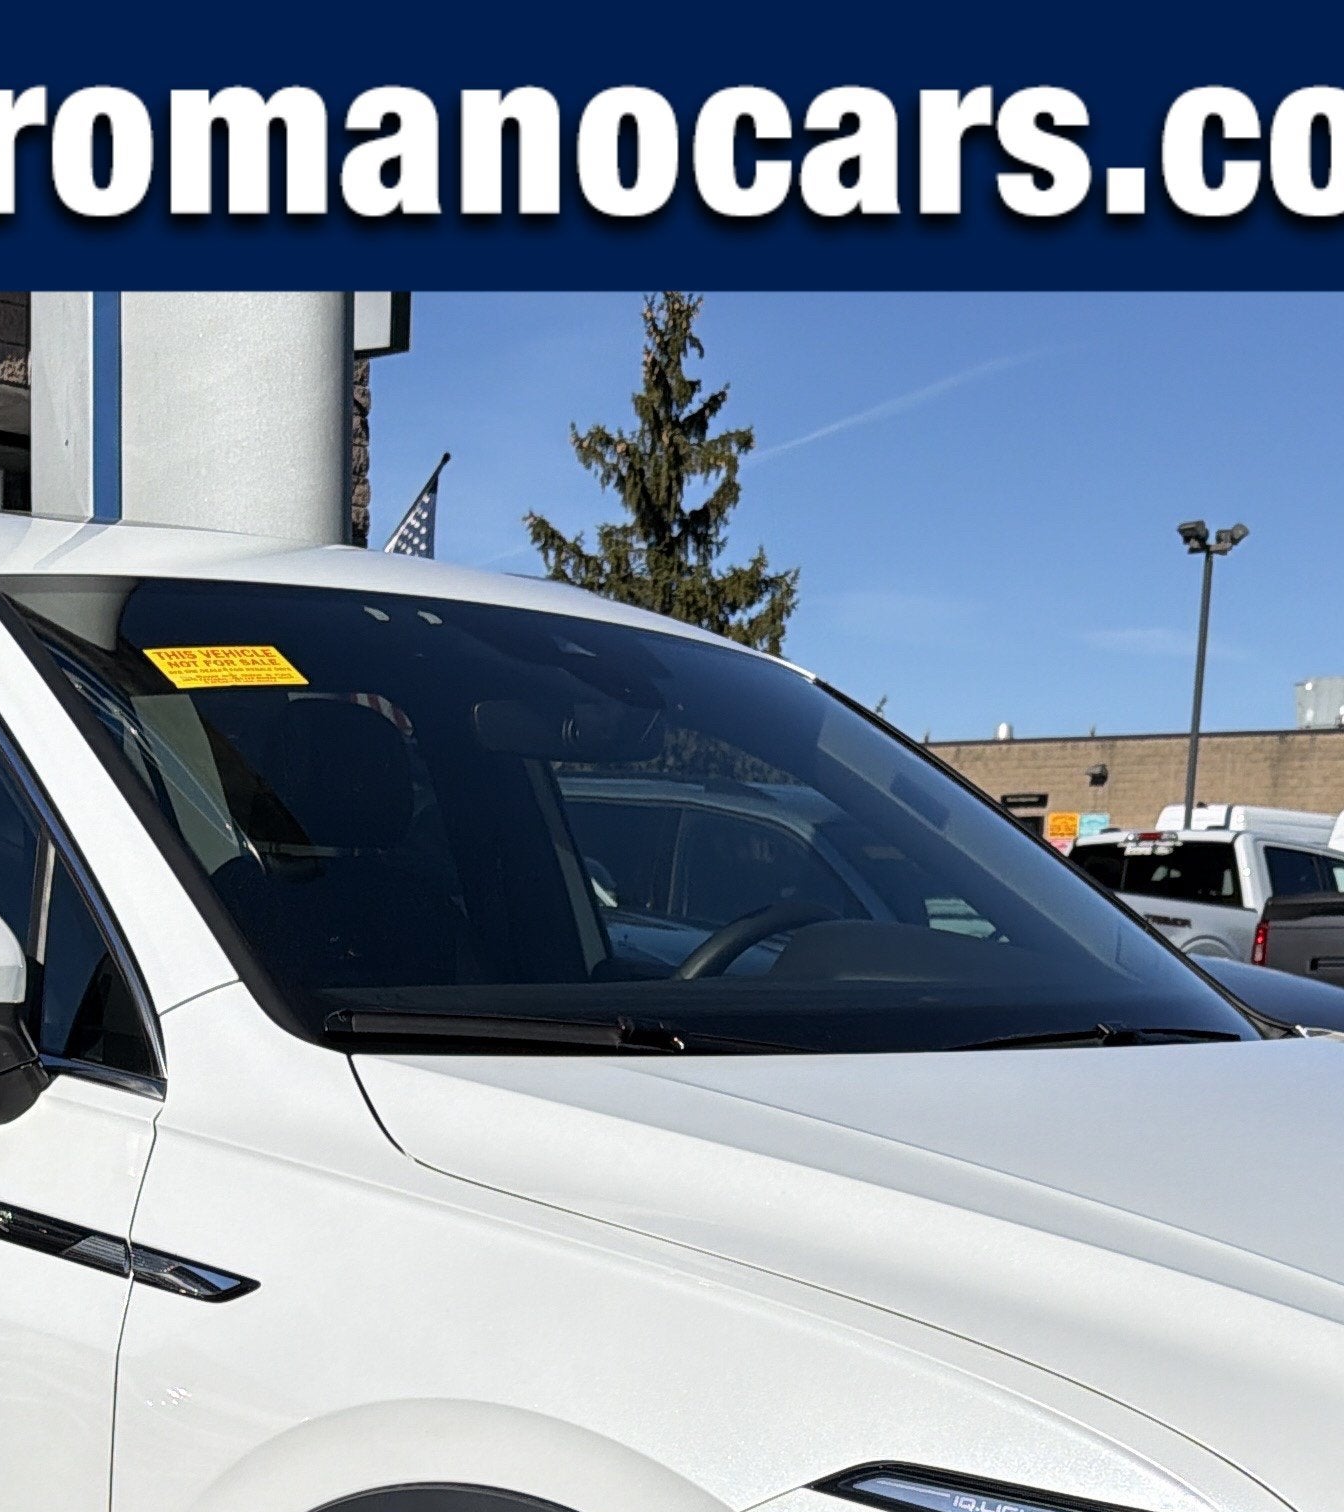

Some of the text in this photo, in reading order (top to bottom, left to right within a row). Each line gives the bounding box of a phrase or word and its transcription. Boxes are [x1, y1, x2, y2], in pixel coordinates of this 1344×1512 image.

[152, 648, 278, 661] THIS VEHICLE
[167, 658, 282, 669] NOT FOR SALE
